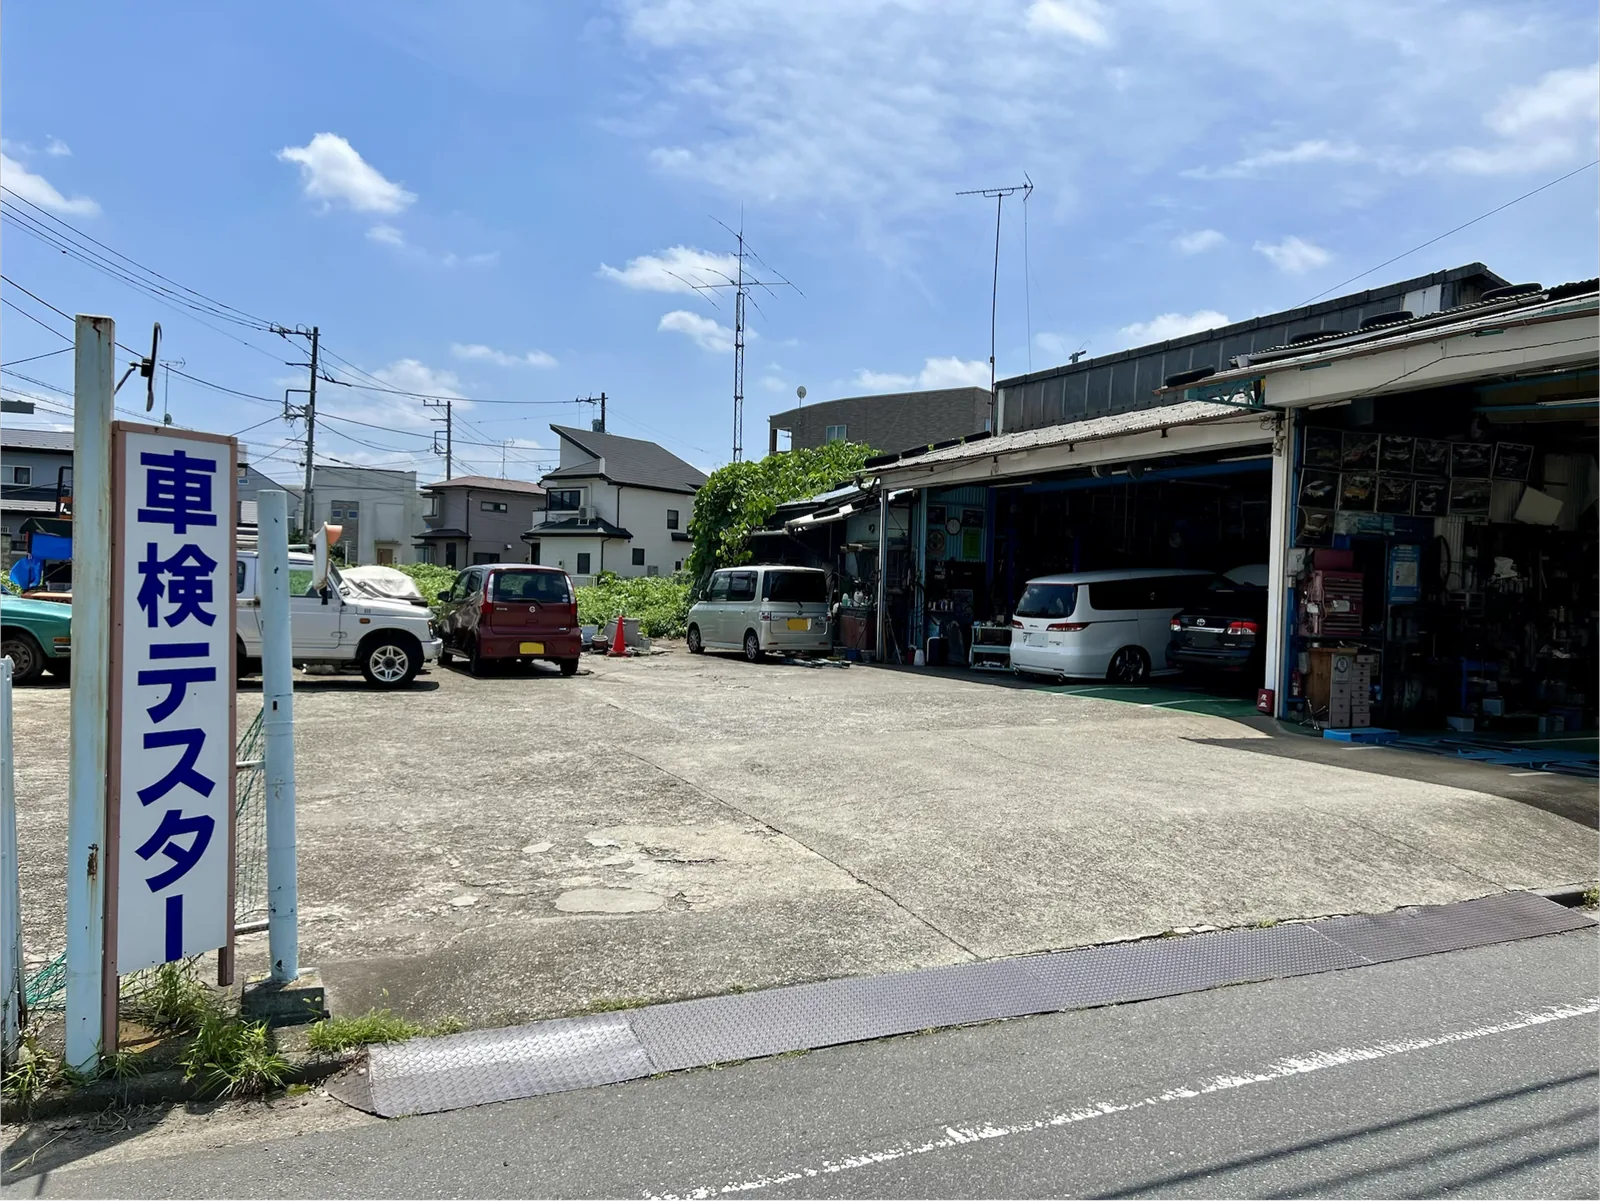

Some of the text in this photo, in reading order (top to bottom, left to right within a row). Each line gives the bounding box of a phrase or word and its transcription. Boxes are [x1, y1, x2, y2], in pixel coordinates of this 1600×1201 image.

[135, 450, 217, 961] 車検テスター
